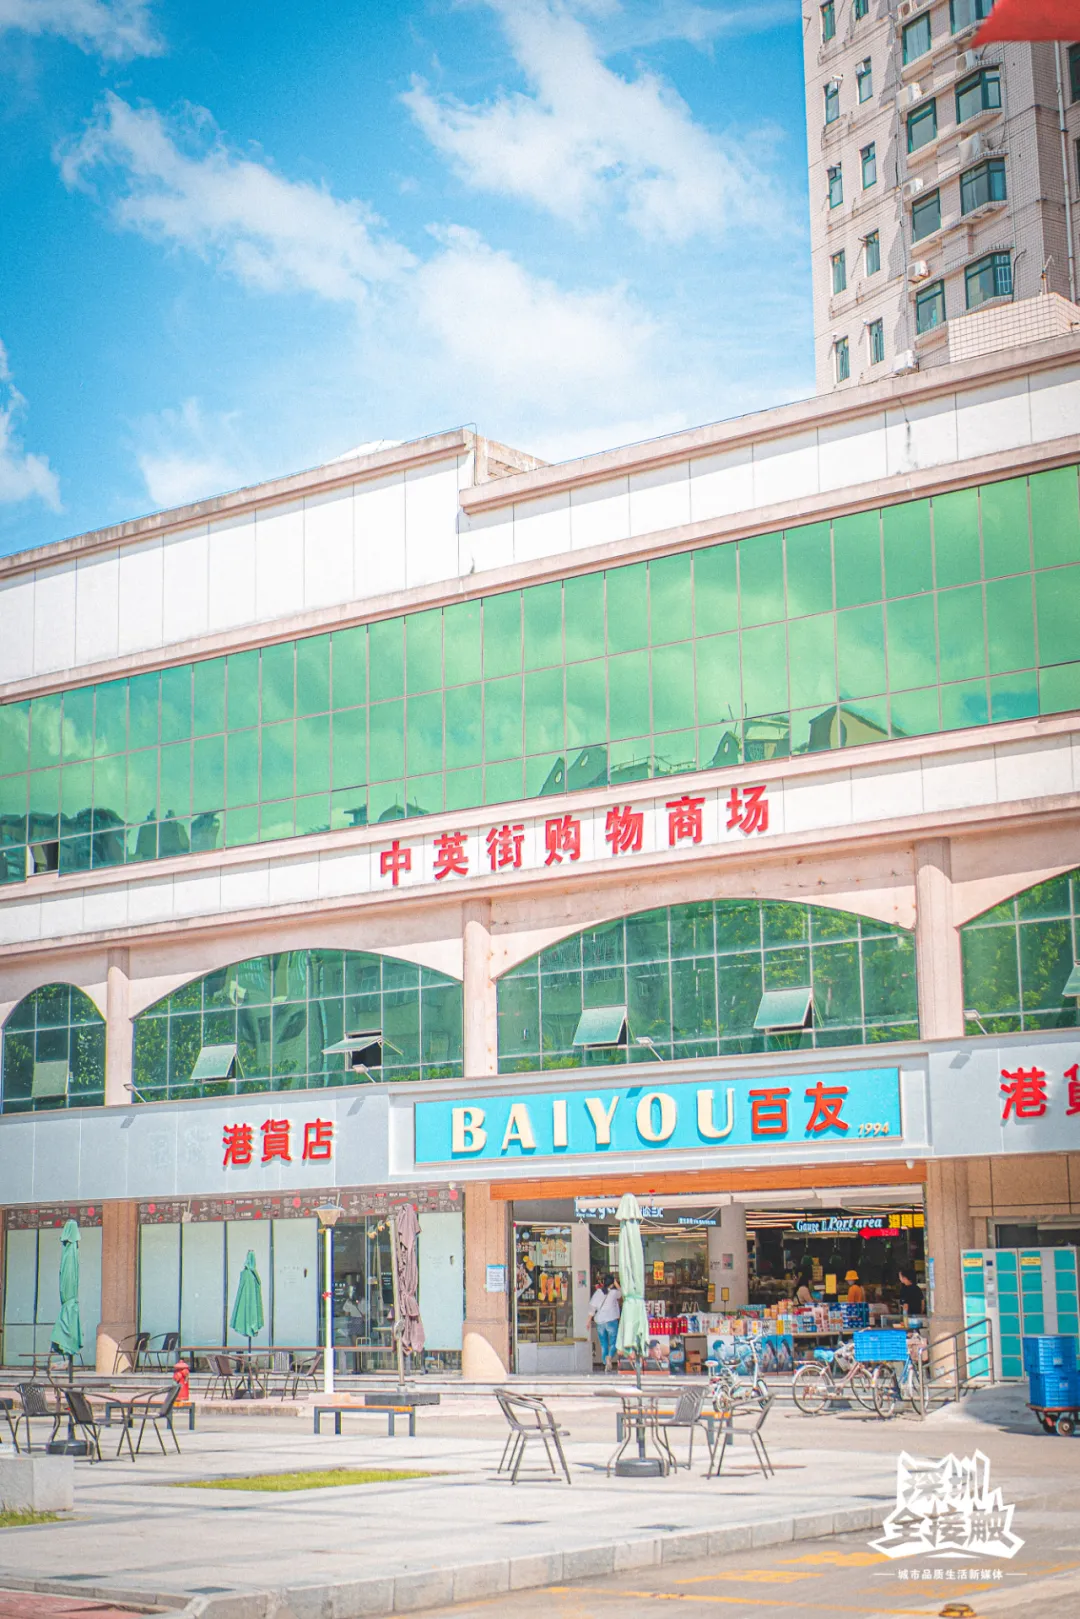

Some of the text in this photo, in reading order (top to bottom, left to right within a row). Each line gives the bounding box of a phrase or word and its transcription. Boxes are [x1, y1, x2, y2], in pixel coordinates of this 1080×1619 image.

[380, 785, 770, 886] 中英街购物商场
[452, 1081, 850, 1153] BAIYOU 百友
[858, 1121, 890, 1135] 1994
[222, 1118, 333, 1165] 港貨店
[828, 1216, 854, 1230] Port
[855, 1217, 882, 1228] area
